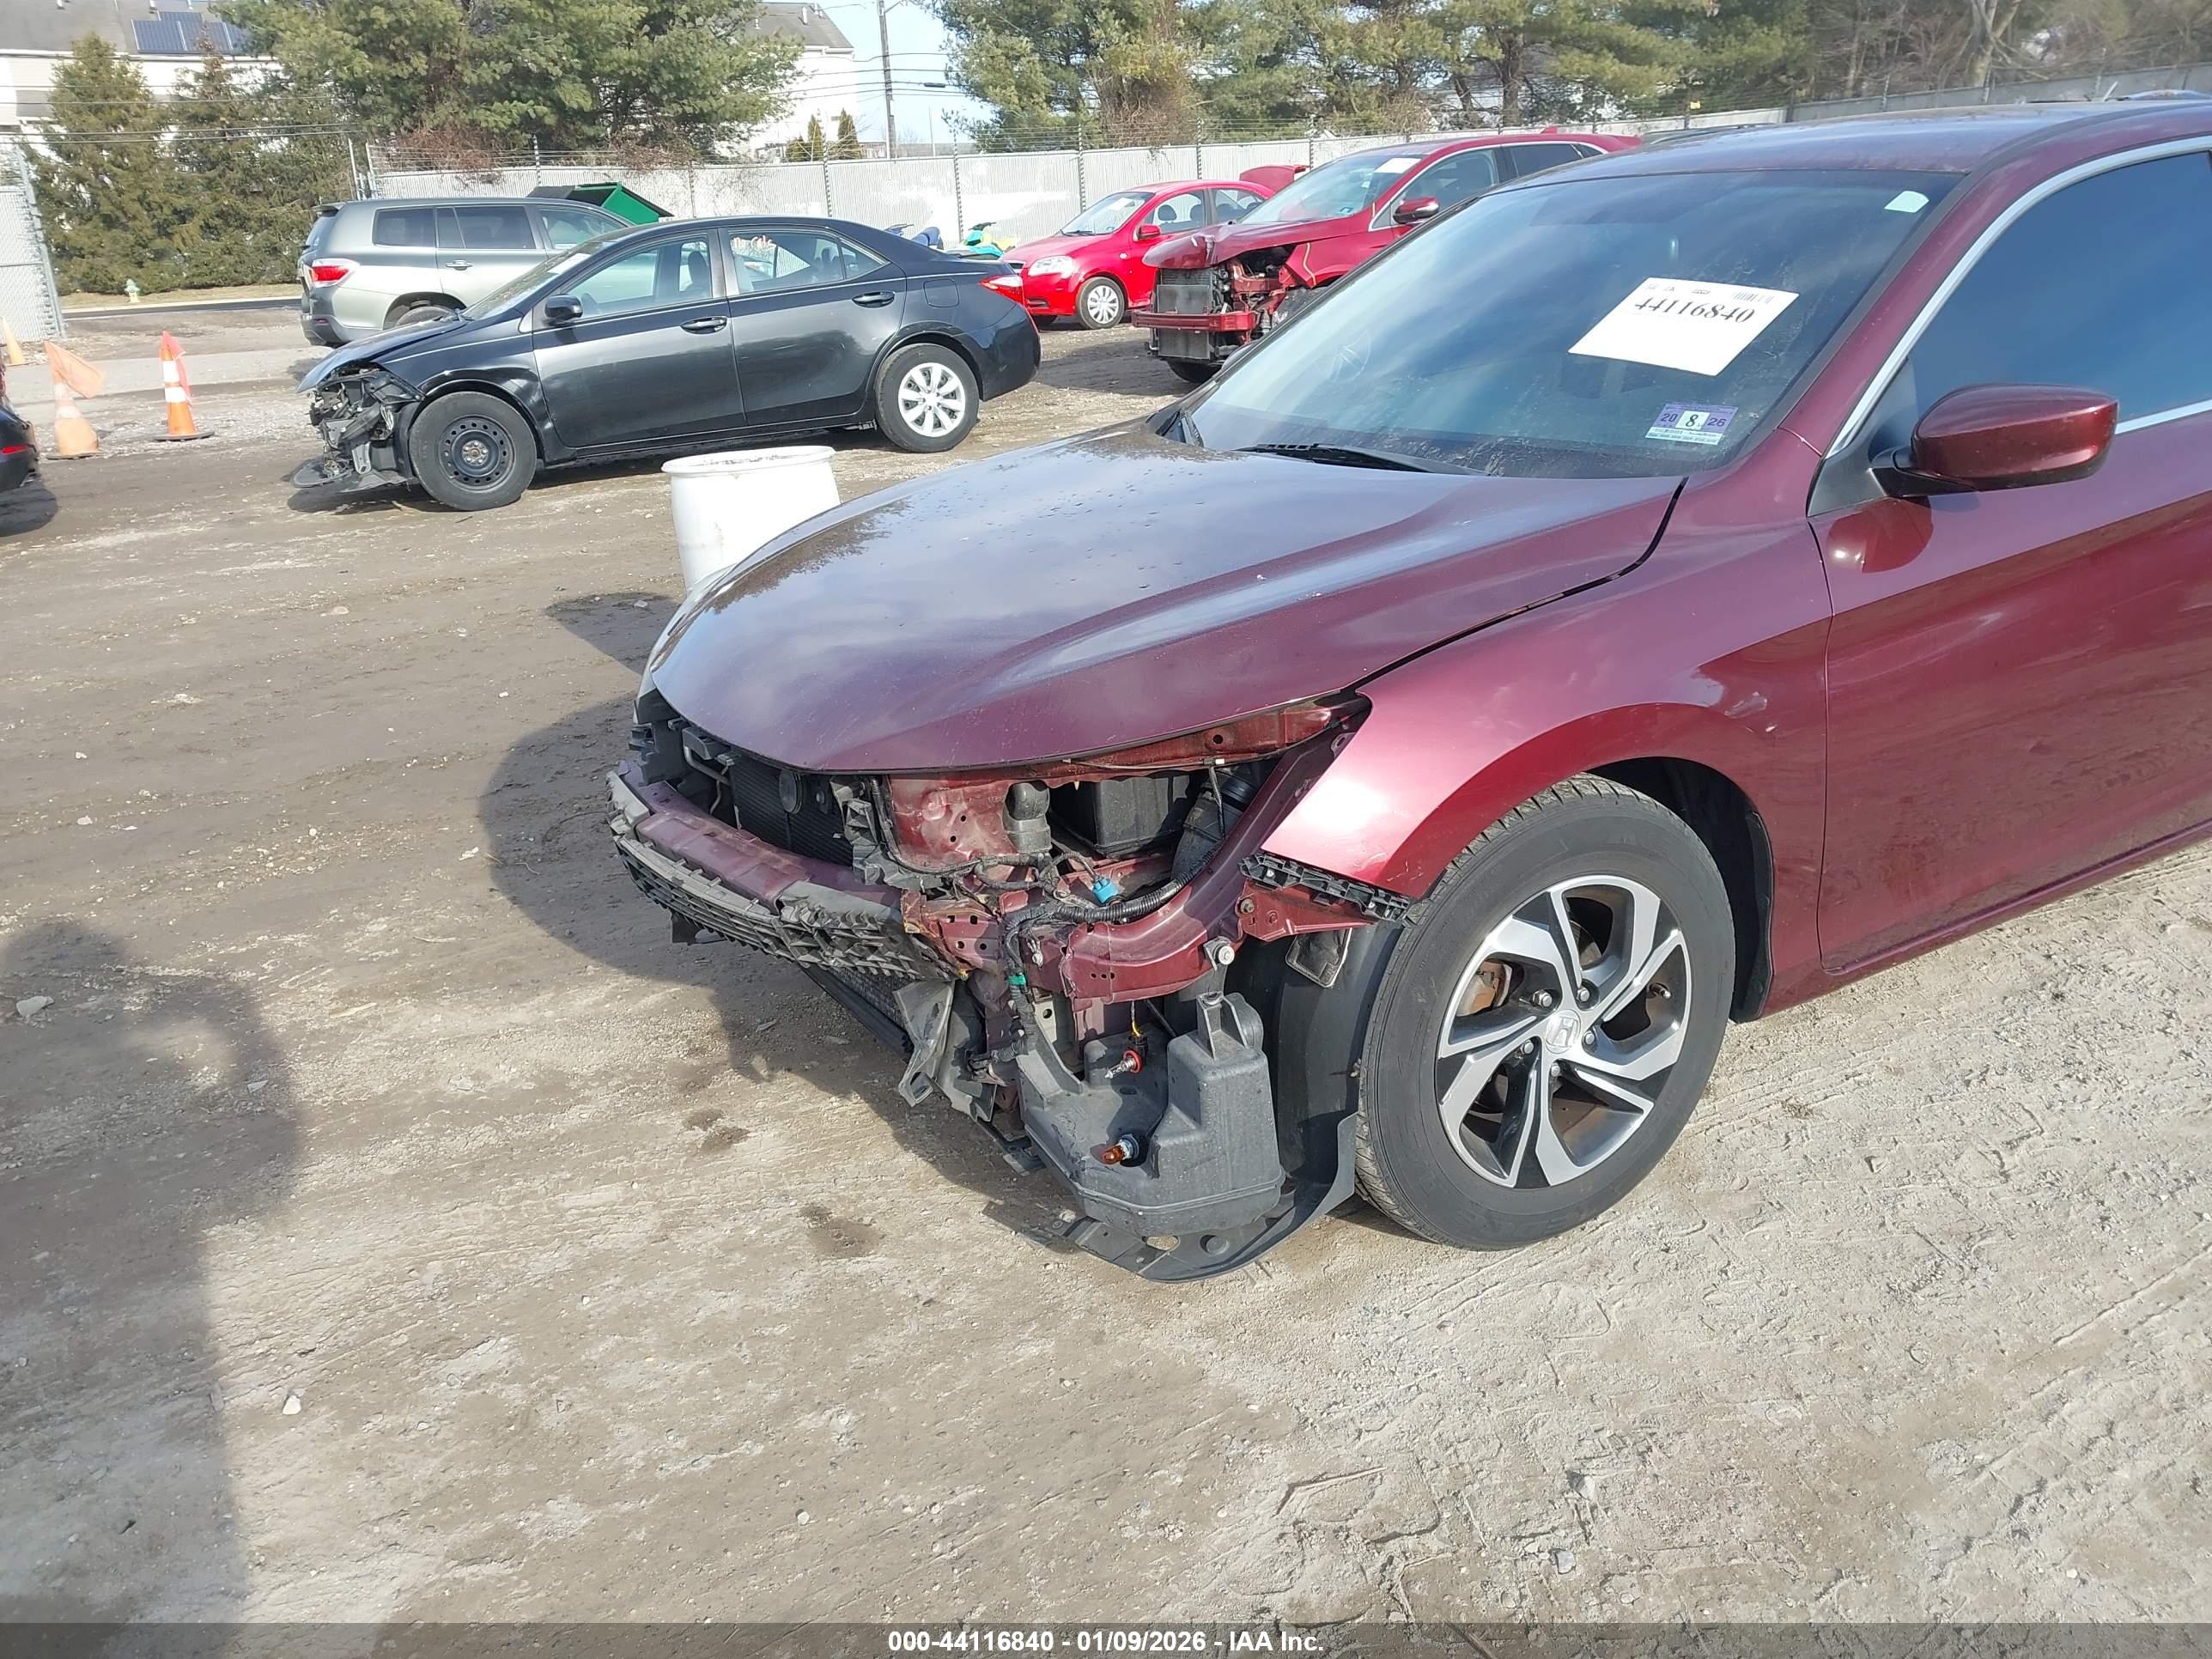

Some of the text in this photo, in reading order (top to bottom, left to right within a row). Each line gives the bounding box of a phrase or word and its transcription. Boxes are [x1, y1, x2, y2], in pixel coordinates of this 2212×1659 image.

[1635, 297, 1755, 323] 44116840
[1661, 413, 1726, 428] 20 8 26
